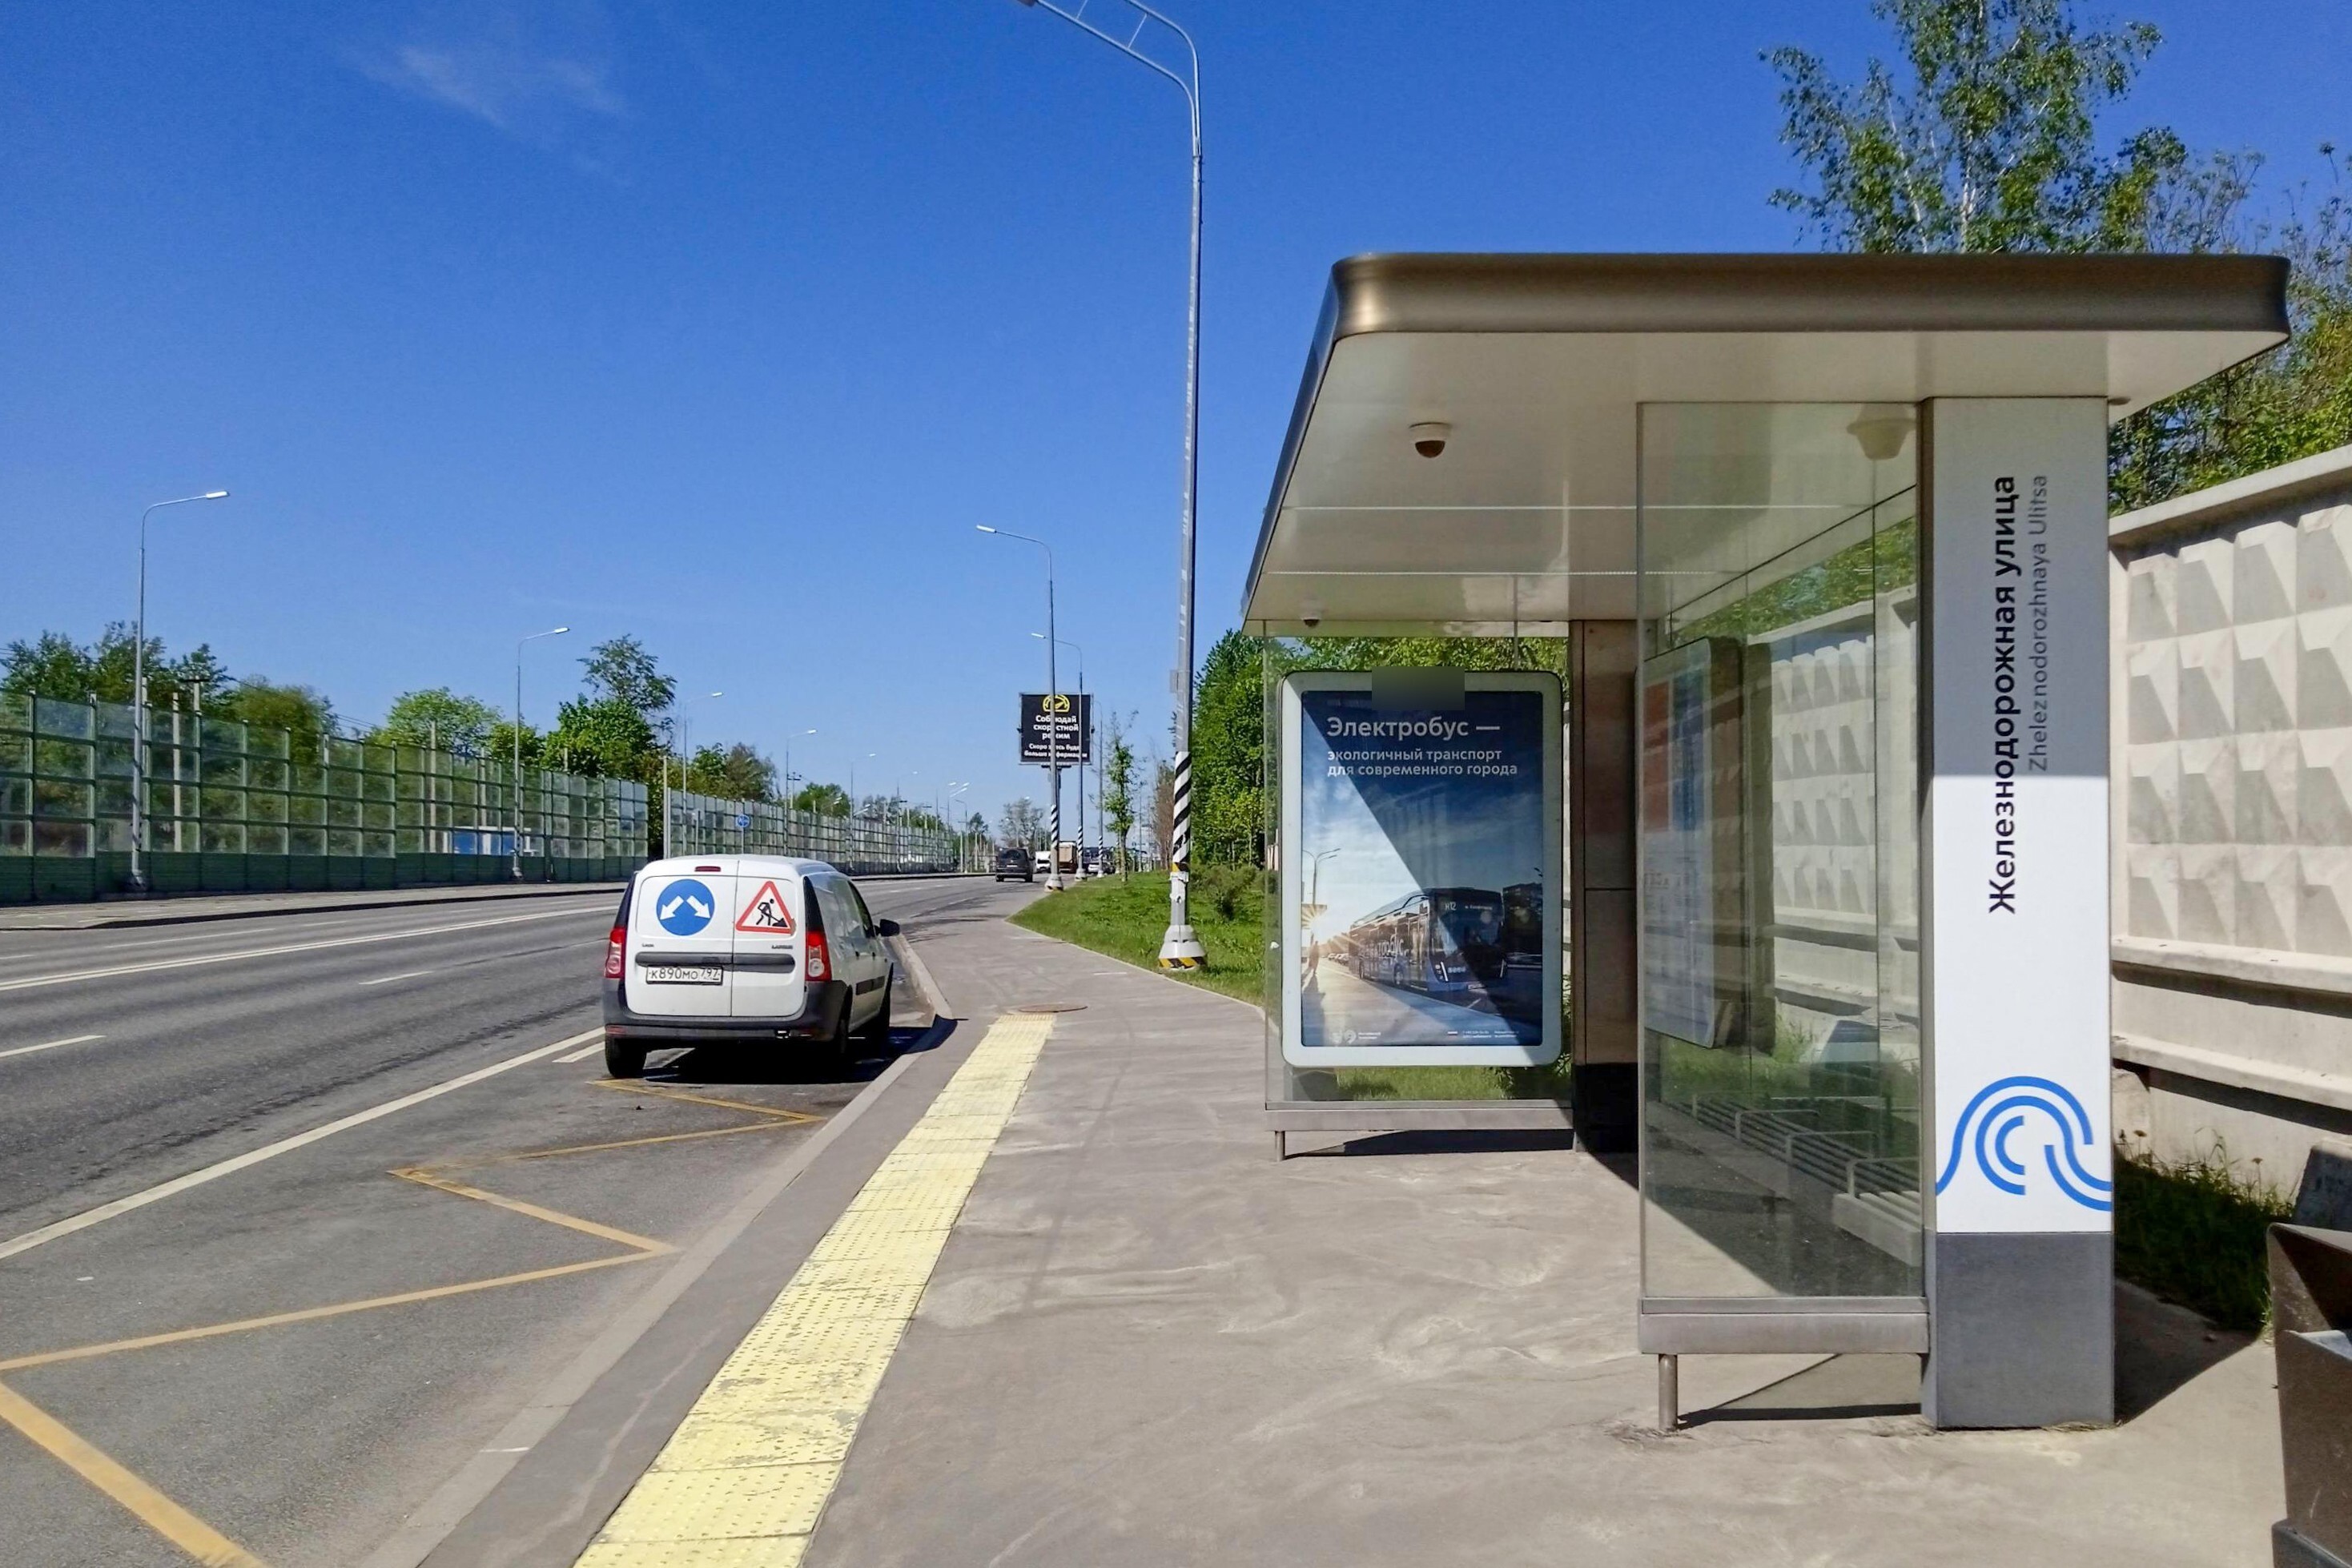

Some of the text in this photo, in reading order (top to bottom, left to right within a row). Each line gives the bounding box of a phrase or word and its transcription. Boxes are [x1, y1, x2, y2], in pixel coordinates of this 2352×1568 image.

[2028, 475, 2051, 772] Zheleznodorozhnaya Ulitsa
[1988, 476, 2022, 915] Железнодорожная улица
[1035, 715, 1076, 724] Собюдай
[1033, 724, 1079, 732] скорстной
[1326, 715, 1469, 742] Электробус
[1327, 747, 1502, 762] экологичный транспорт
[1327, 763, 1518, 778] для современного города
